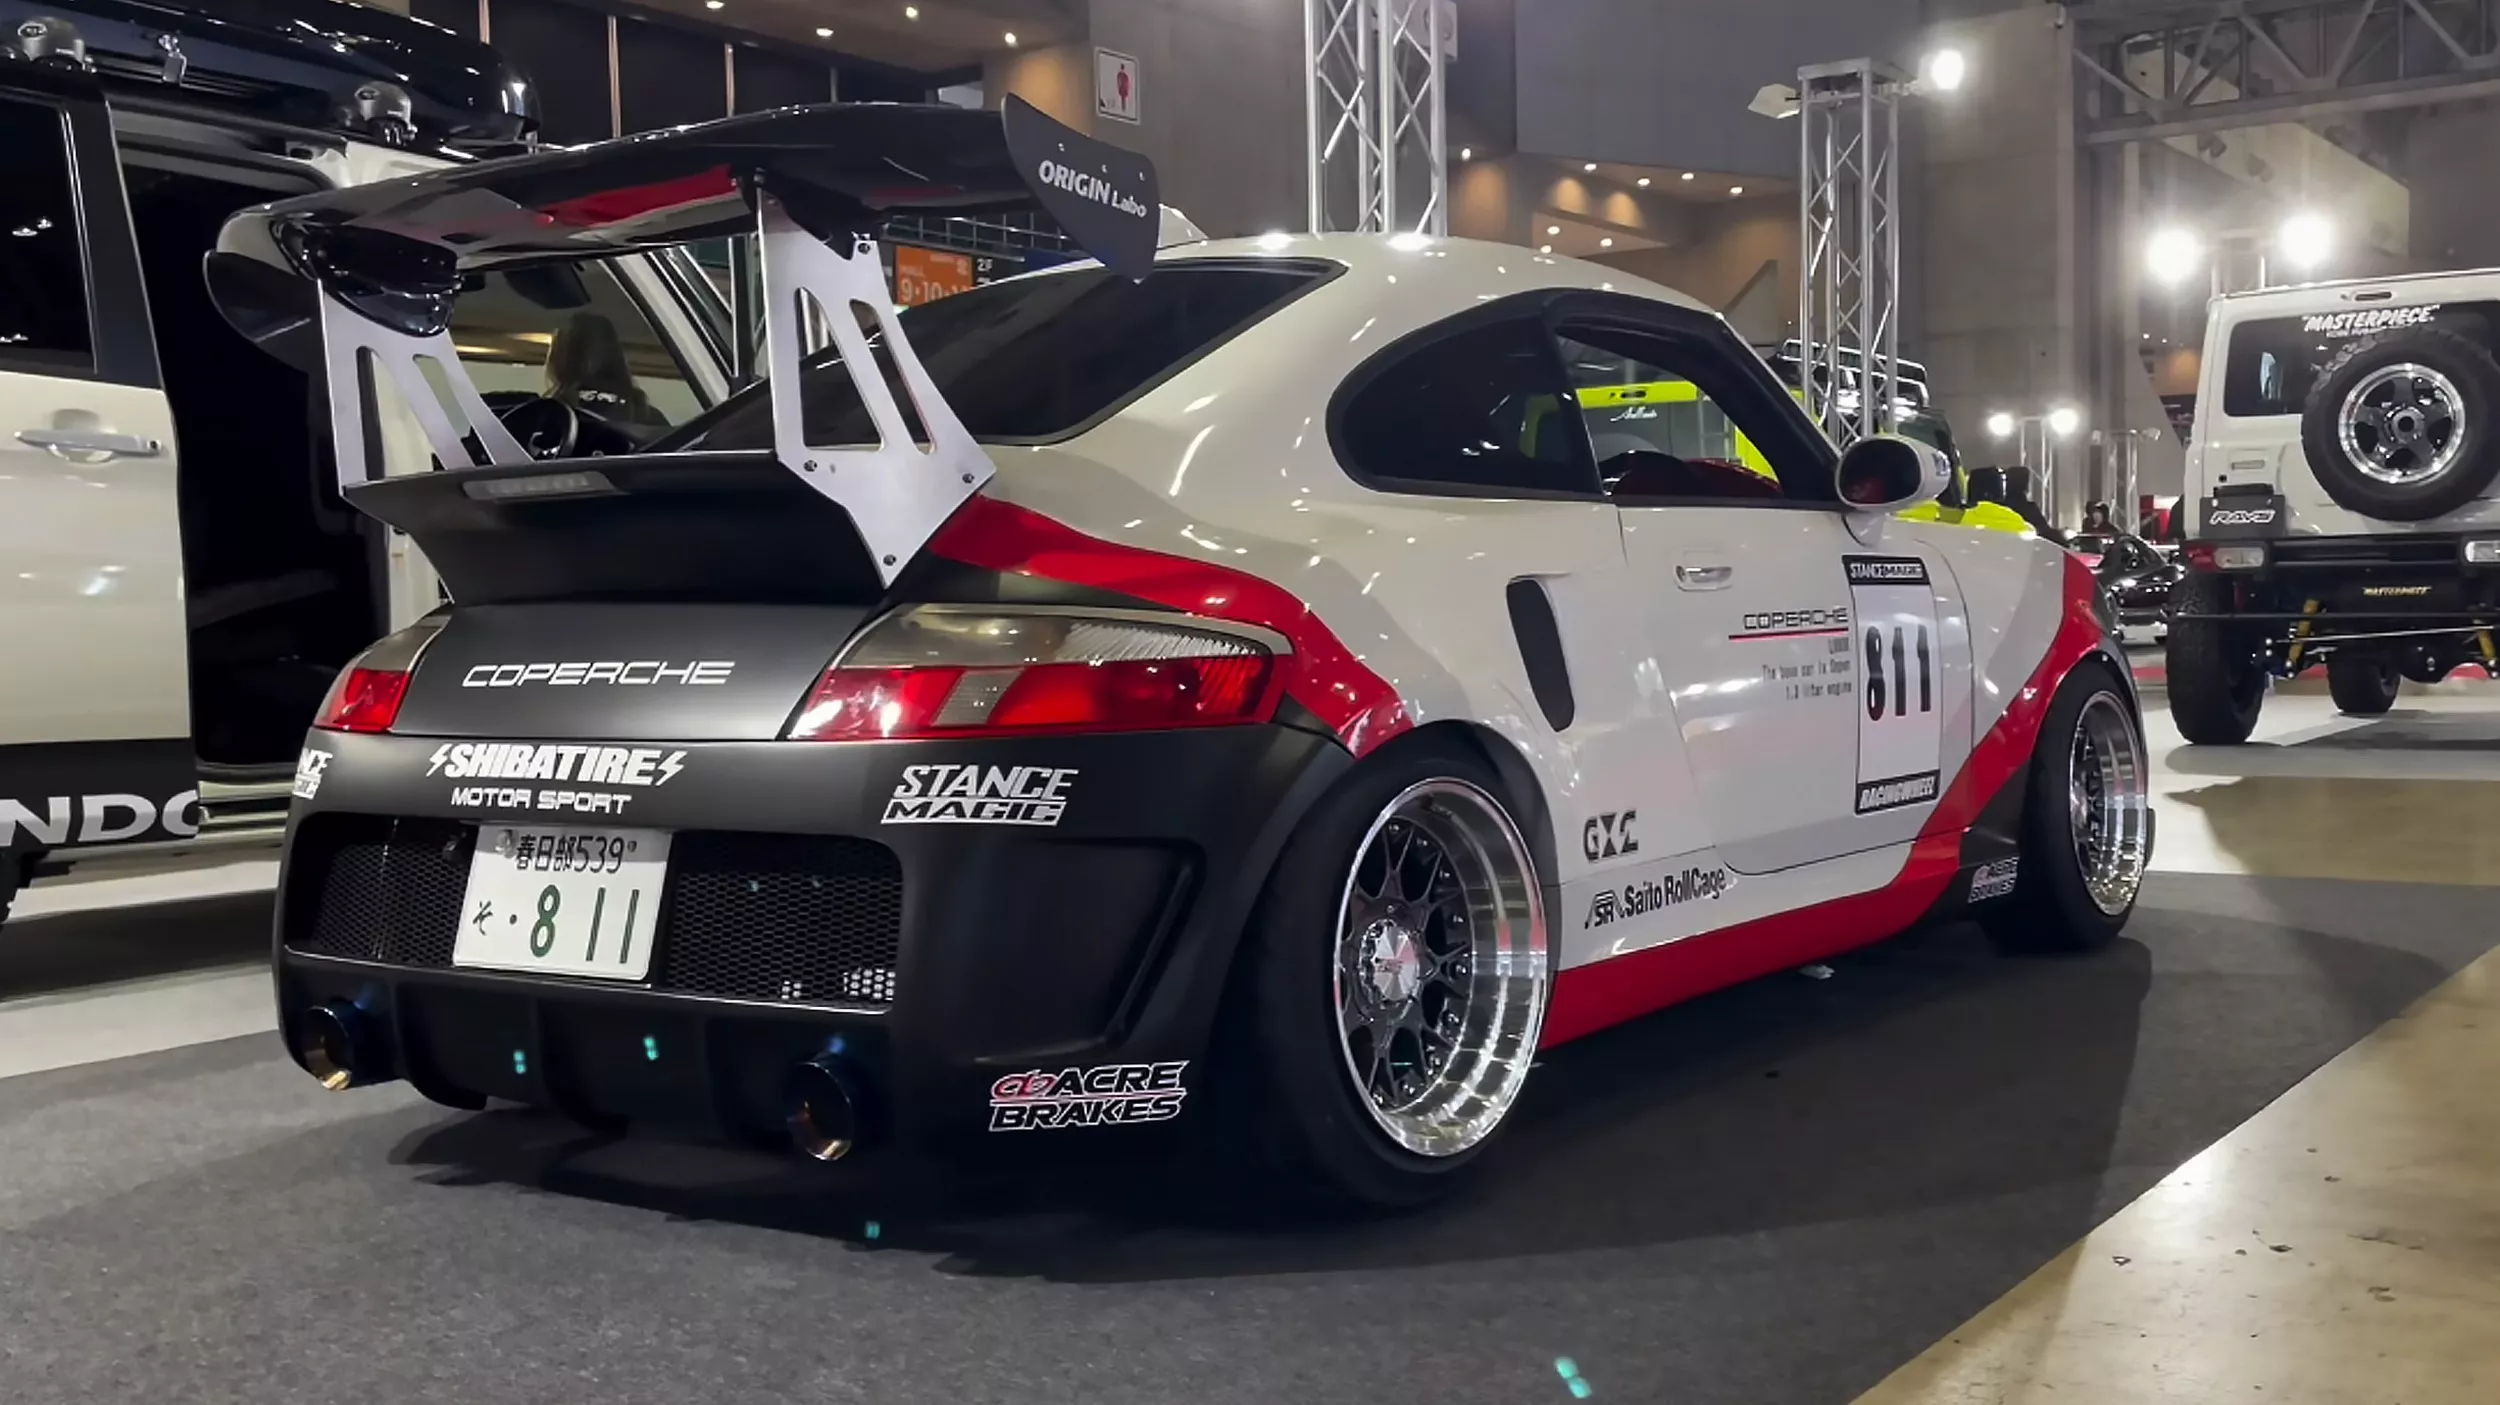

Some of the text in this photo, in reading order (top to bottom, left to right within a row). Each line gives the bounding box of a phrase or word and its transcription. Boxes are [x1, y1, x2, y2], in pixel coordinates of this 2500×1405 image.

[1039, 160, 1111, 205] ORIGIN
[2209, 509, 2276, 525] RAYS
[1744, 606, 1848, 629] COPERCHE
[462, 661, 735, 687] COPERCHE
[1866, 624, 1932, 722] 811
[445, 743, 662, 785] SHIBATIRE
[893, 764, 1079, 801] STANCE
[451, 787, 632, 814] MOTOR SPORT
[883, 799, 1065, 825] MAGIC
[990, 1094, 1186, 1132] BRAKES
